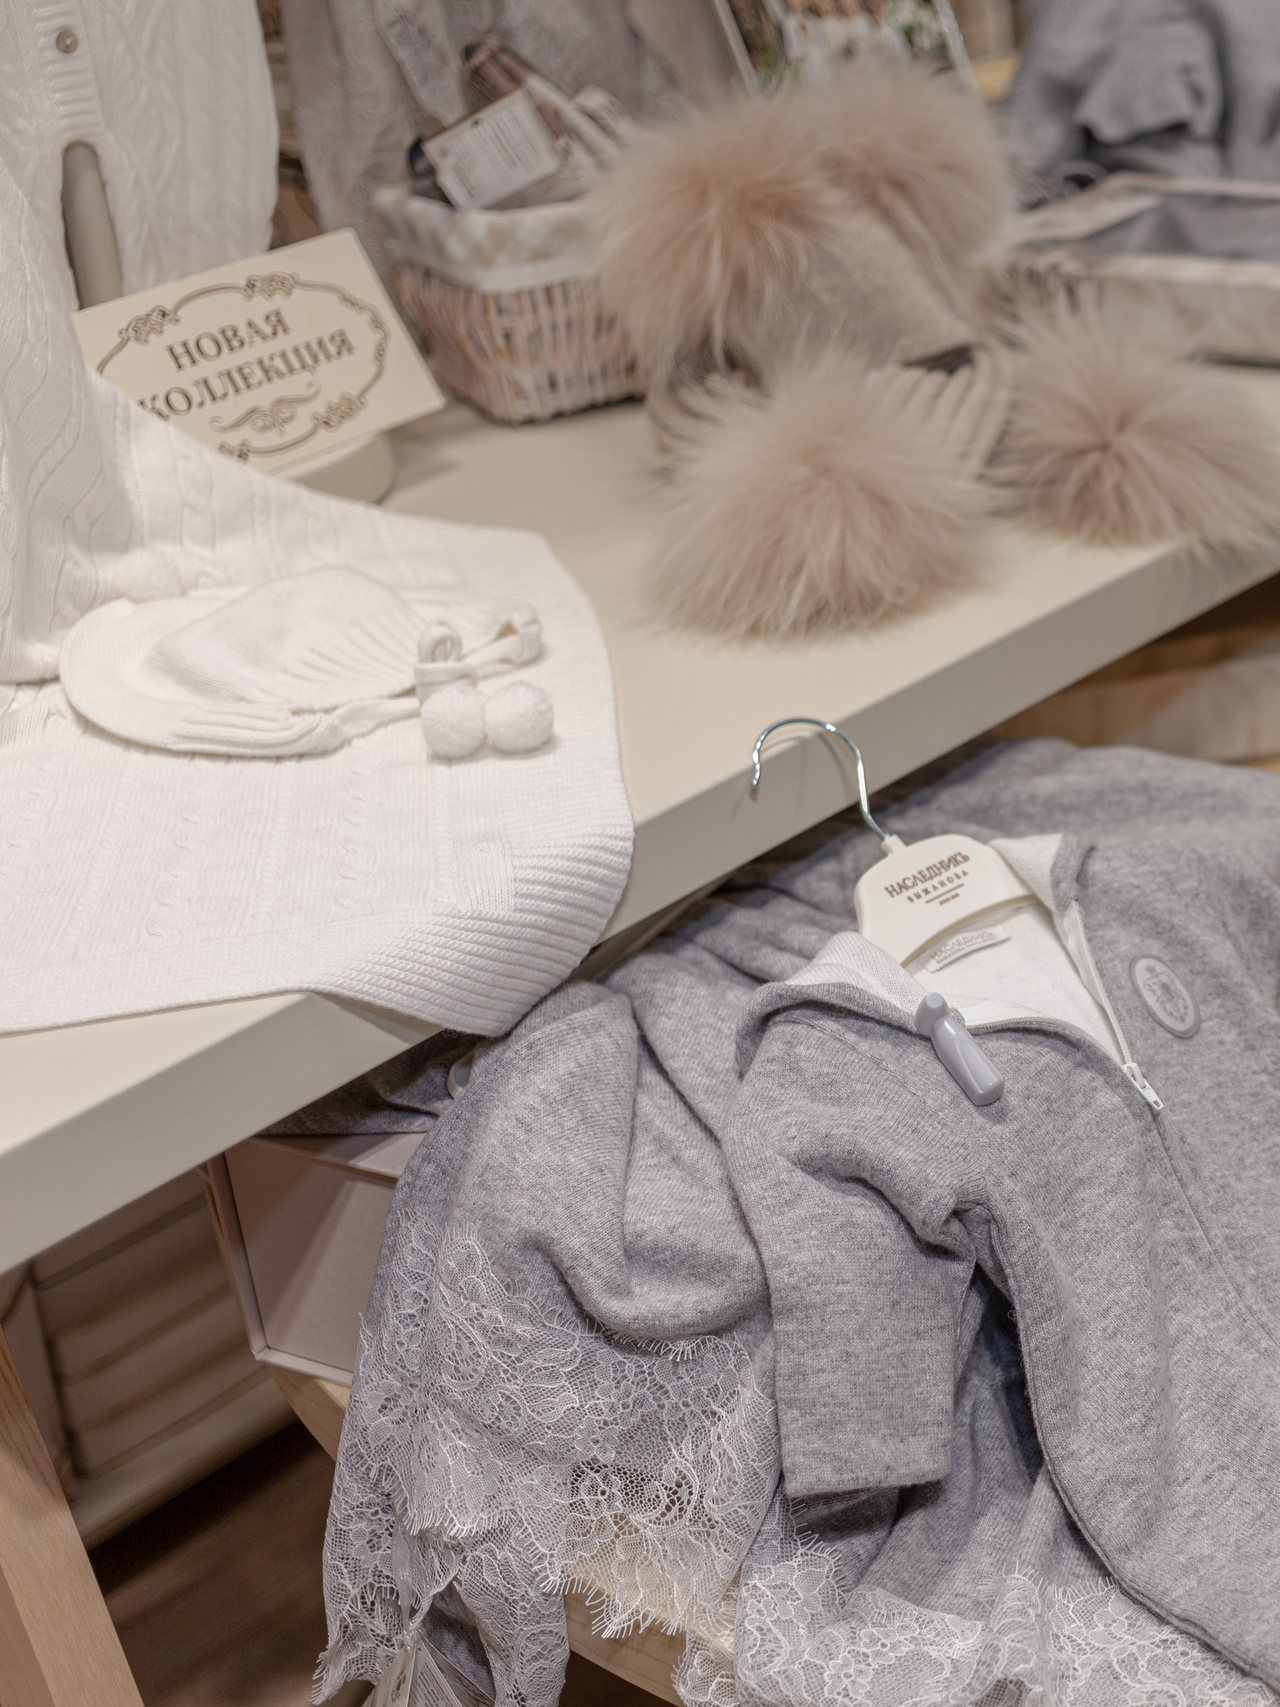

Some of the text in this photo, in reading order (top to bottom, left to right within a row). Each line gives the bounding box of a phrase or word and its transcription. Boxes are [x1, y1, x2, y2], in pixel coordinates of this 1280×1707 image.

[166, 309, 291, 371] НОВАЯ
[139, 329, 354, 421] КОЛЛЕКЦИЯ
[885, 852, 970, 898] НАСЛЕДНИКЪ
